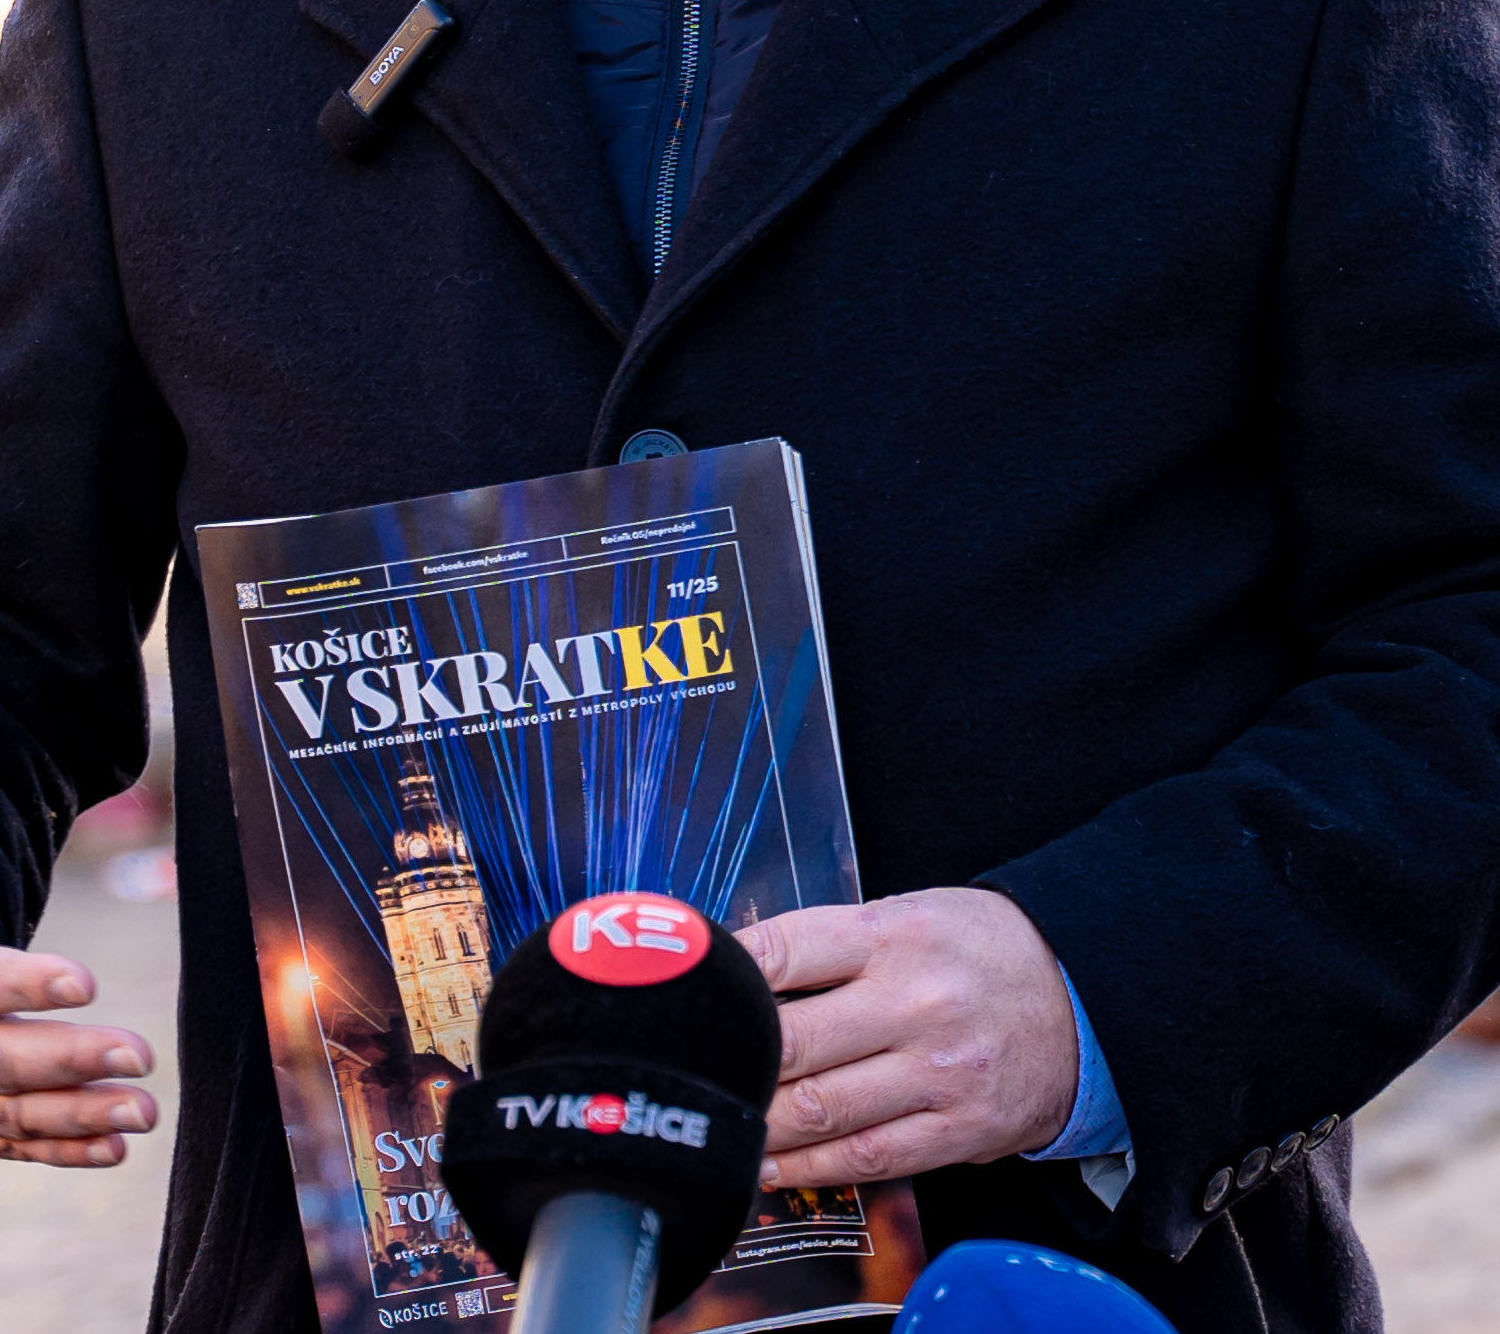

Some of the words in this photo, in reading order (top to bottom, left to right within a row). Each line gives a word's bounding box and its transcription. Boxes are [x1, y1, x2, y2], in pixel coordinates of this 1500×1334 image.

[369, 46, 405, 85] BOYA
[422, 550, 529, 576] facebook.com/vskratke
[285, 576, 361, 597] www.vskratke.sk
[666, 575, 720, 600] 11/25
[269, 625, 414, 674] KOŠICE
[274, 674, 335, 740] V
[346, 610, 734, 734] SKRATKE
[288, 740, 358, 760] MESAČNÍK
[449, 726, 460, 737] A
[461, 710, 564, 736] ZAUJÍMAVOSTÍ
[568, 708, 578, 719] Z
[581, 693, 664, 716] METROPOLY
[669, 680, 738, 701] VÝCHODU
[572, 903, 690, 955] KE
[497, 1093, 557, 1130] TV
[393, 1246, 419, 1261] str.
[421, 1244, 440, 1256] 22
[394, 1301, 449, 1324] KOŠICE
